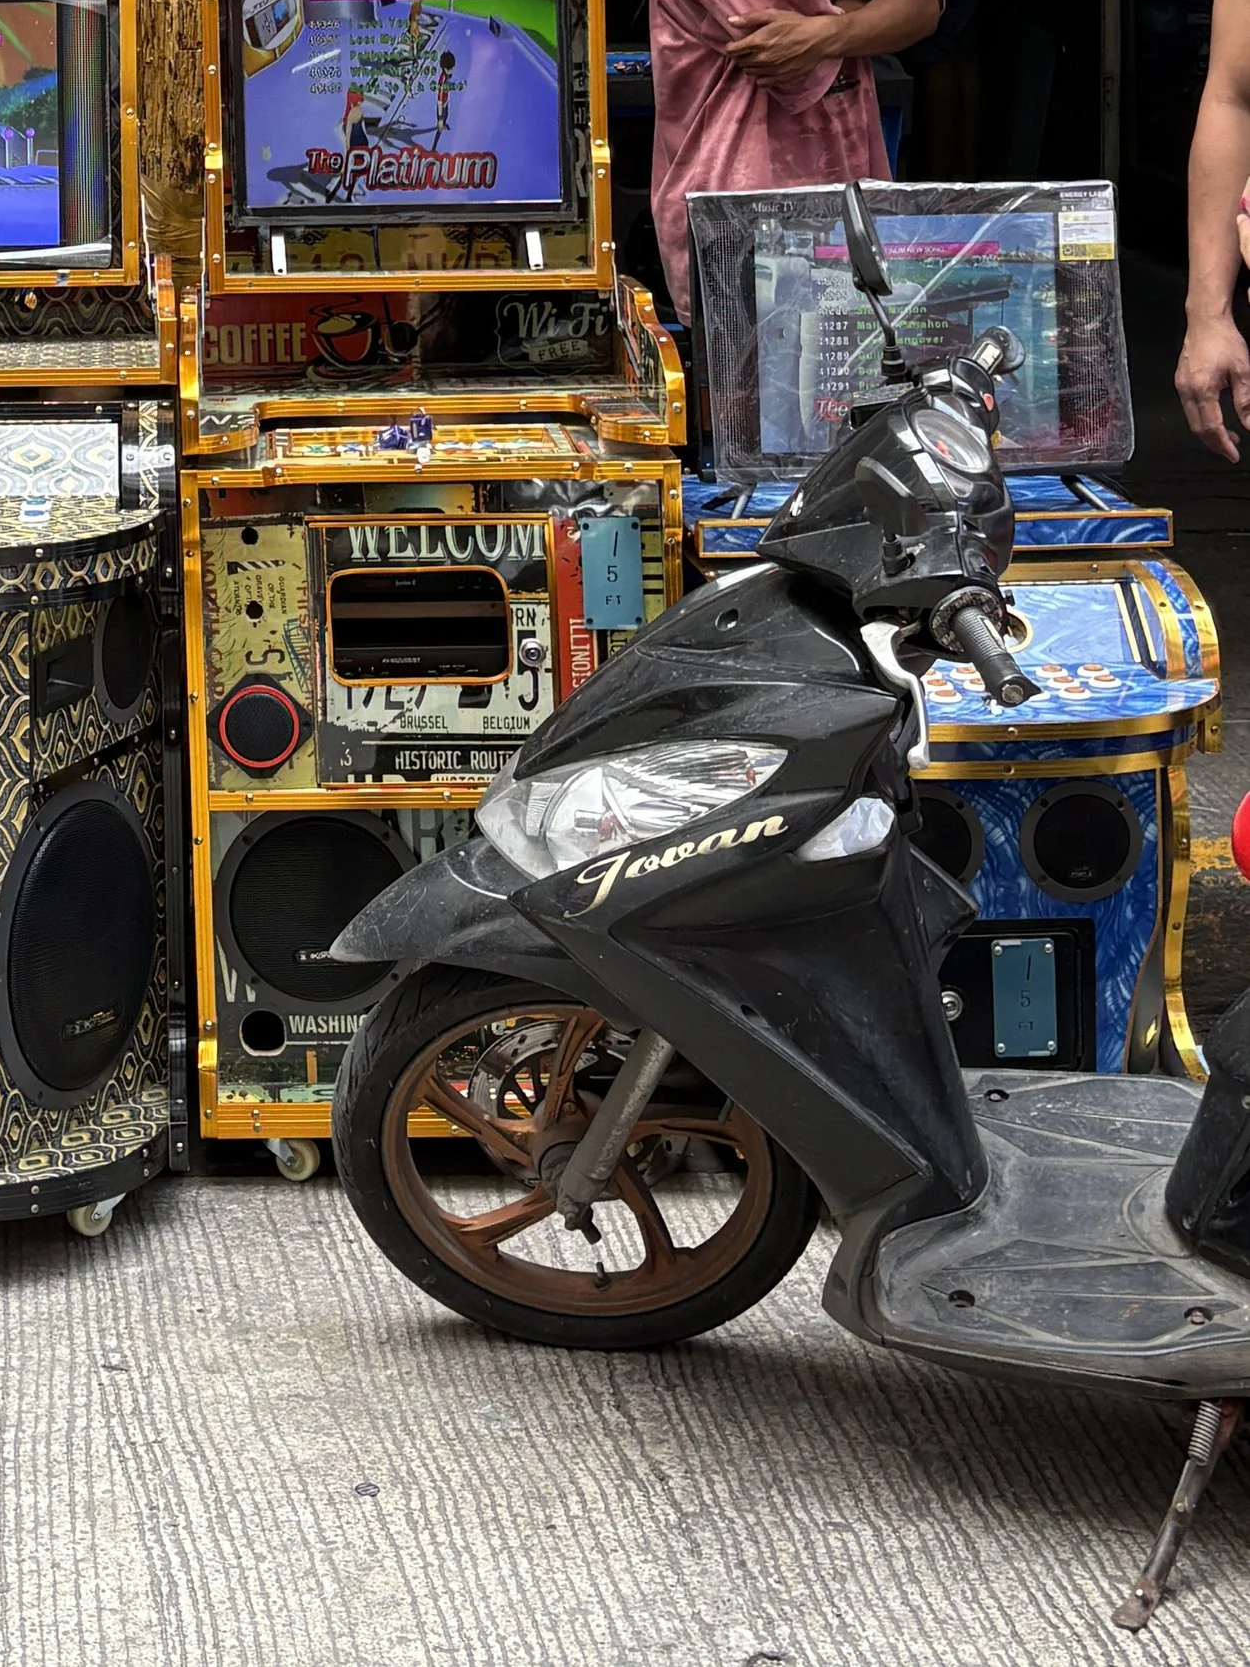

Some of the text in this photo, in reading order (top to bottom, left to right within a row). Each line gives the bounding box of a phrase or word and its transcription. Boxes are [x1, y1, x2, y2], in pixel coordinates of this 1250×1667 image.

[347, 149, 497, 188] Platinum
[503, 301, 610, 339] Wi Fi
[203, 322, 308, 365] COFFEE
[538, 340, 582, 361] FREE
[349, 524, 547, 562] WELCOM
[607, 565, 619, 582] 5
[605, 594, 622, 605] FT
[399, 715, 449, 730] BRUSSEL
[483, 715, 531, 730] BELGIUM
[395, 750, 462, 770] HISTORIC
[563, 815, 790, 919] Jovan
[1019, 991, 1031, 1008] 5
